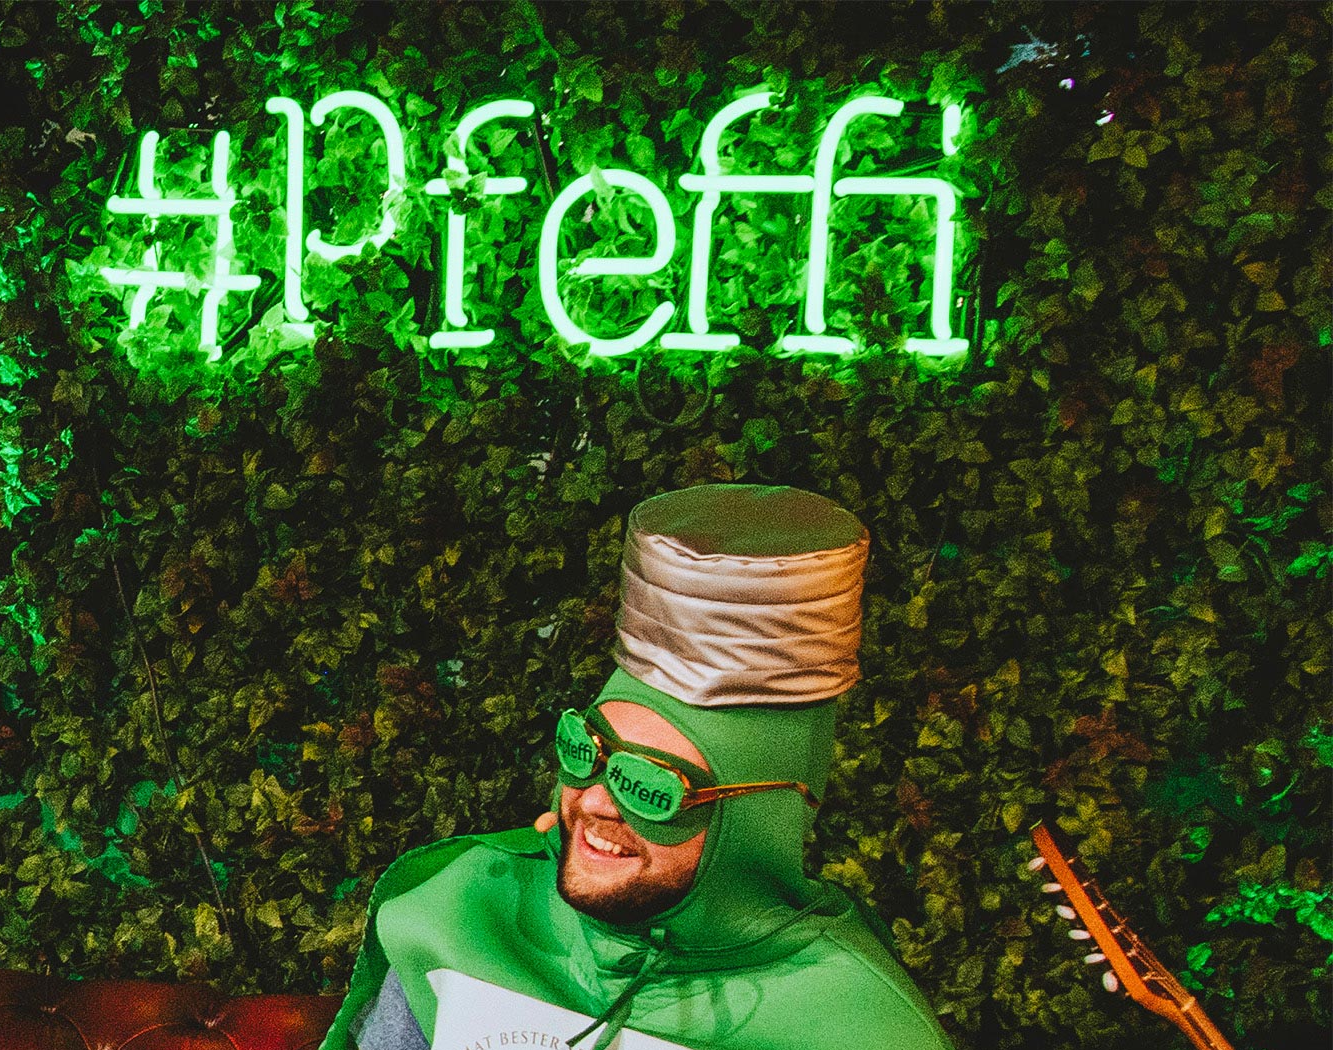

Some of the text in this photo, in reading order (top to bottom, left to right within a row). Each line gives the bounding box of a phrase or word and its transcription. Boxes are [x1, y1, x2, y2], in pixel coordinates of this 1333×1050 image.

[102, 90, 969, 358] #Pfeffi
[608, 764, 673, 812] #pfeffi
[499, 1030, 560, 1050] BESTER
